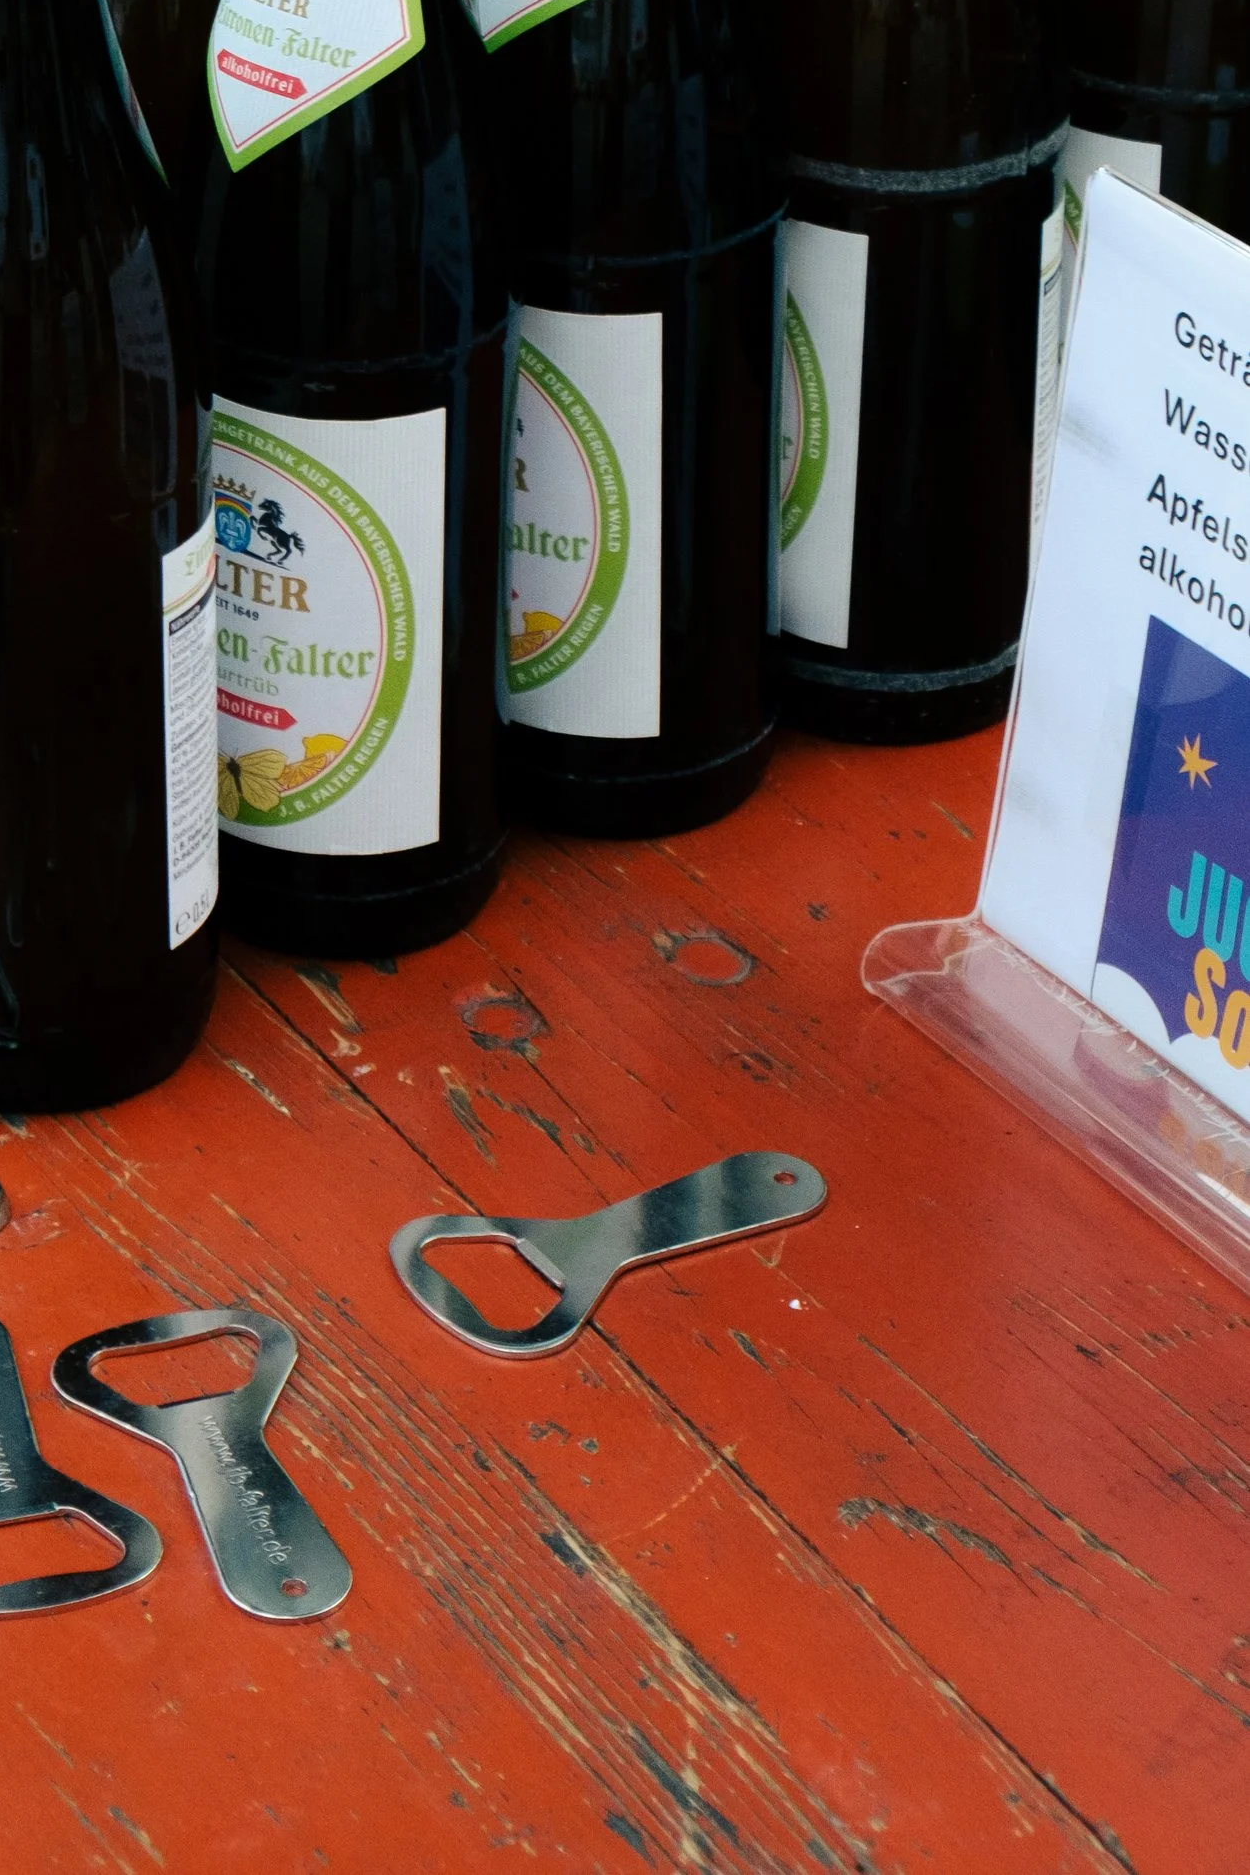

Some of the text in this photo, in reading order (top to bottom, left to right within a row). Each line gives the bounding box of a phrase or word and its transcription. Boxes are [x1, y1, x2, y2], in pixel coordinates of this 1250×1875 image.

[221, 55, 294, 94] alkoholfrei
[543, 372, 575, 403] DEM
[569, 404, 619, 506] BAYERISCHEN
[607, 508, 622, 554] WALD
[1164, 387, 1250, 473] Wass
[296, 462, 331, 489] AUS
[327, 485, 363, 518] DEM
[355, 514, 406, 615] BAYERISCHEN
[392, 616, 408, 662] WALD
[1146, 472, 1249, 563] Apfels
[232, 603, 260, 622] 1649
[1138, 544, 1250, 633] alkoho
[532, 644, 576, 679] FALTER
[569, 603, 606, 647] REGEN
[311, 762, 360, 805] FALTER
[352, 716, 390, 764] REGEN
